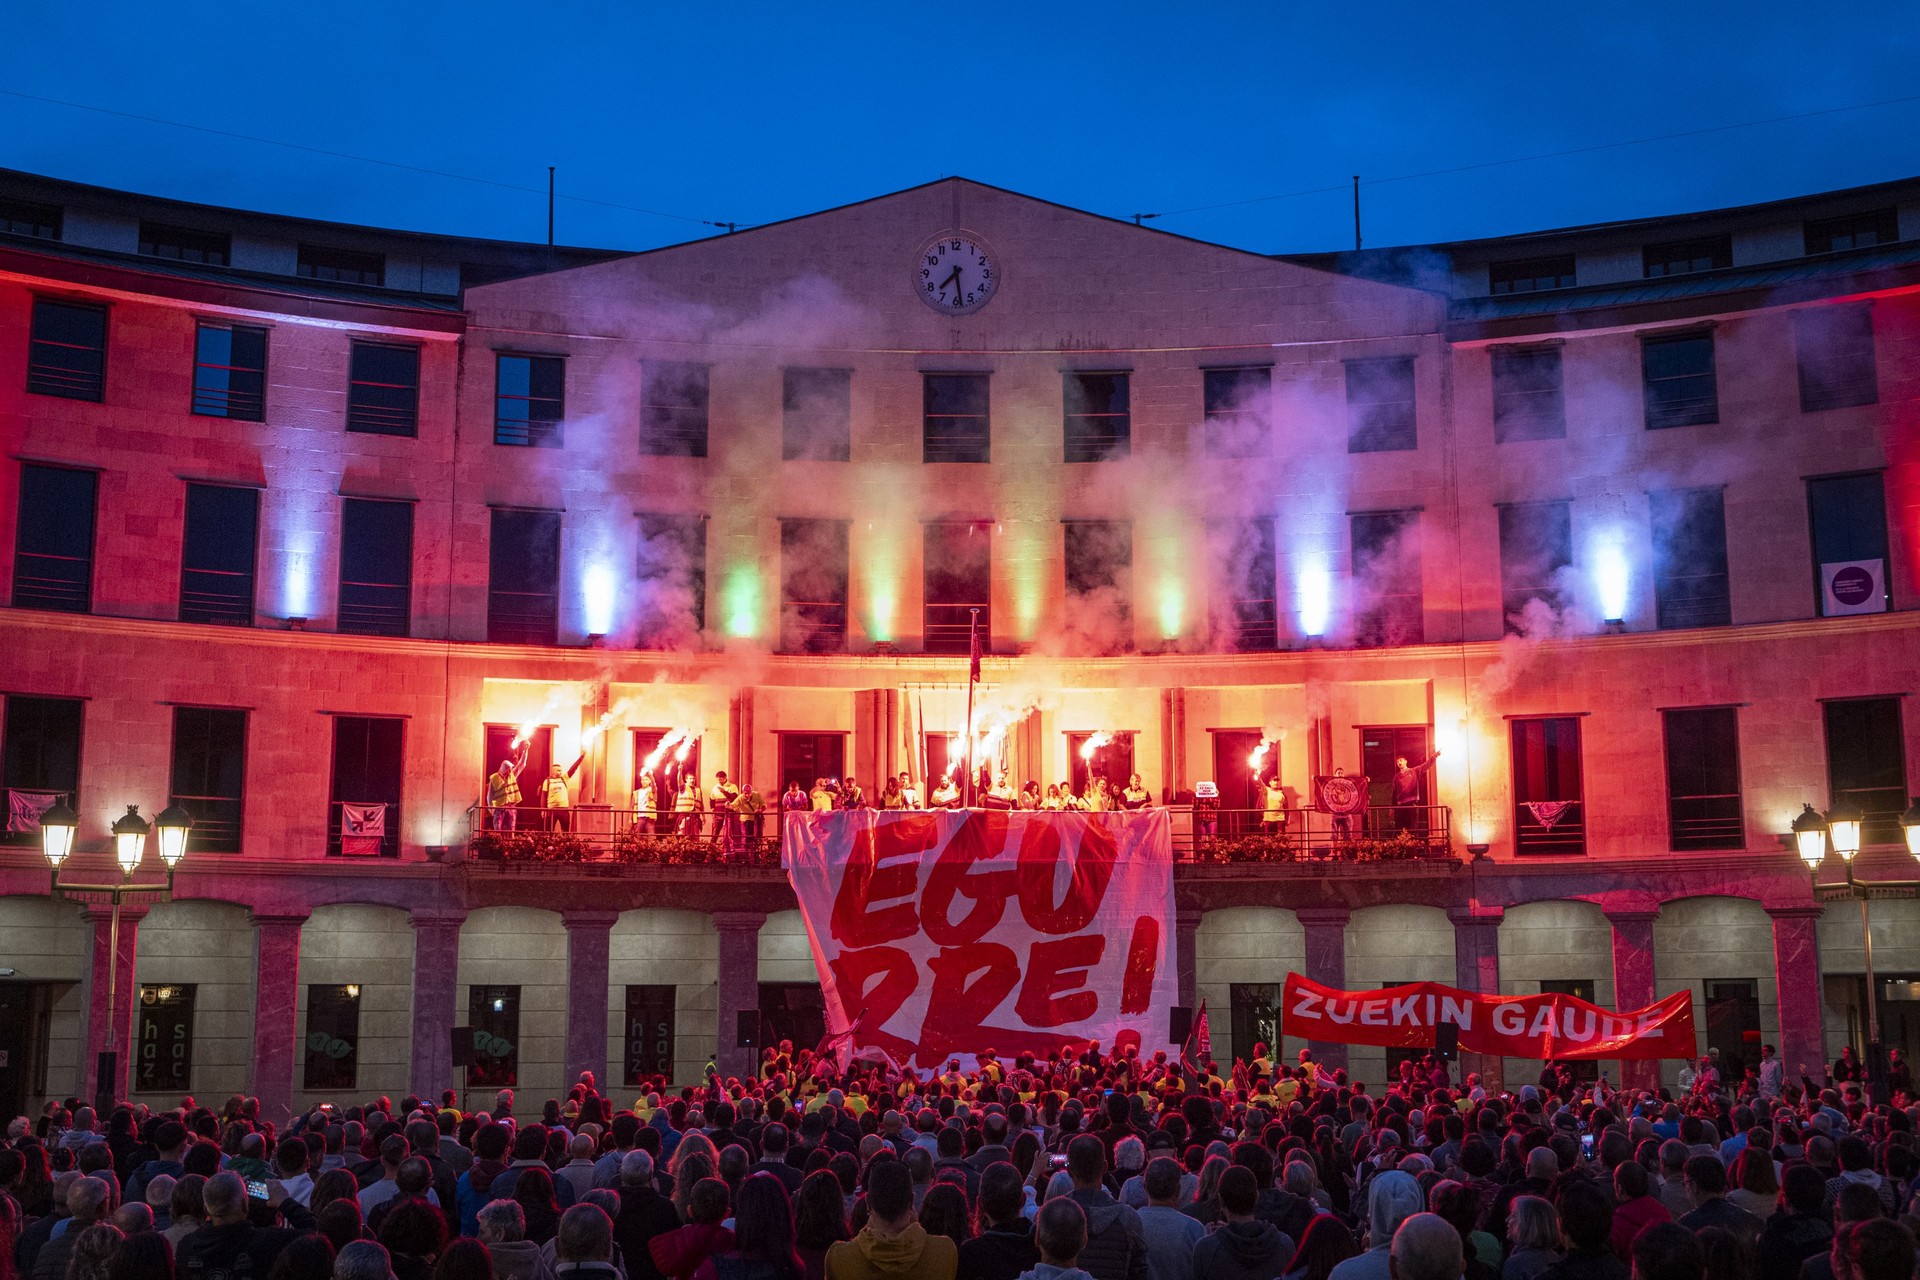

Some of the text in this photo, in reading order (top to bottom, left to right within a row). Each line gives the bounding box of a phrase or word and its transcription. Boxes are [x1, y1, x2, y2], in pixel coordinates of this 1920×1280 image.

[938, 246, 945, 255] 11
[951, 241, 961, 250] 12
[928, 256, 938, 266] 10
[978, 256, 986, 266] 2
[923, 269, 930, 279] 9
[983, 269, 990, 279] 3
[927, 282, 935, 292] 8
[977, 283, 985, 292] 4
[939, 292, 946, 302] 7
[952, 296, 960, 306] 6
[967, 293, 974, 303] 5
[830, 809, 1118, 948] EGU
[1292, 987, 1663, 1042] ZUEKIN GAUDE
